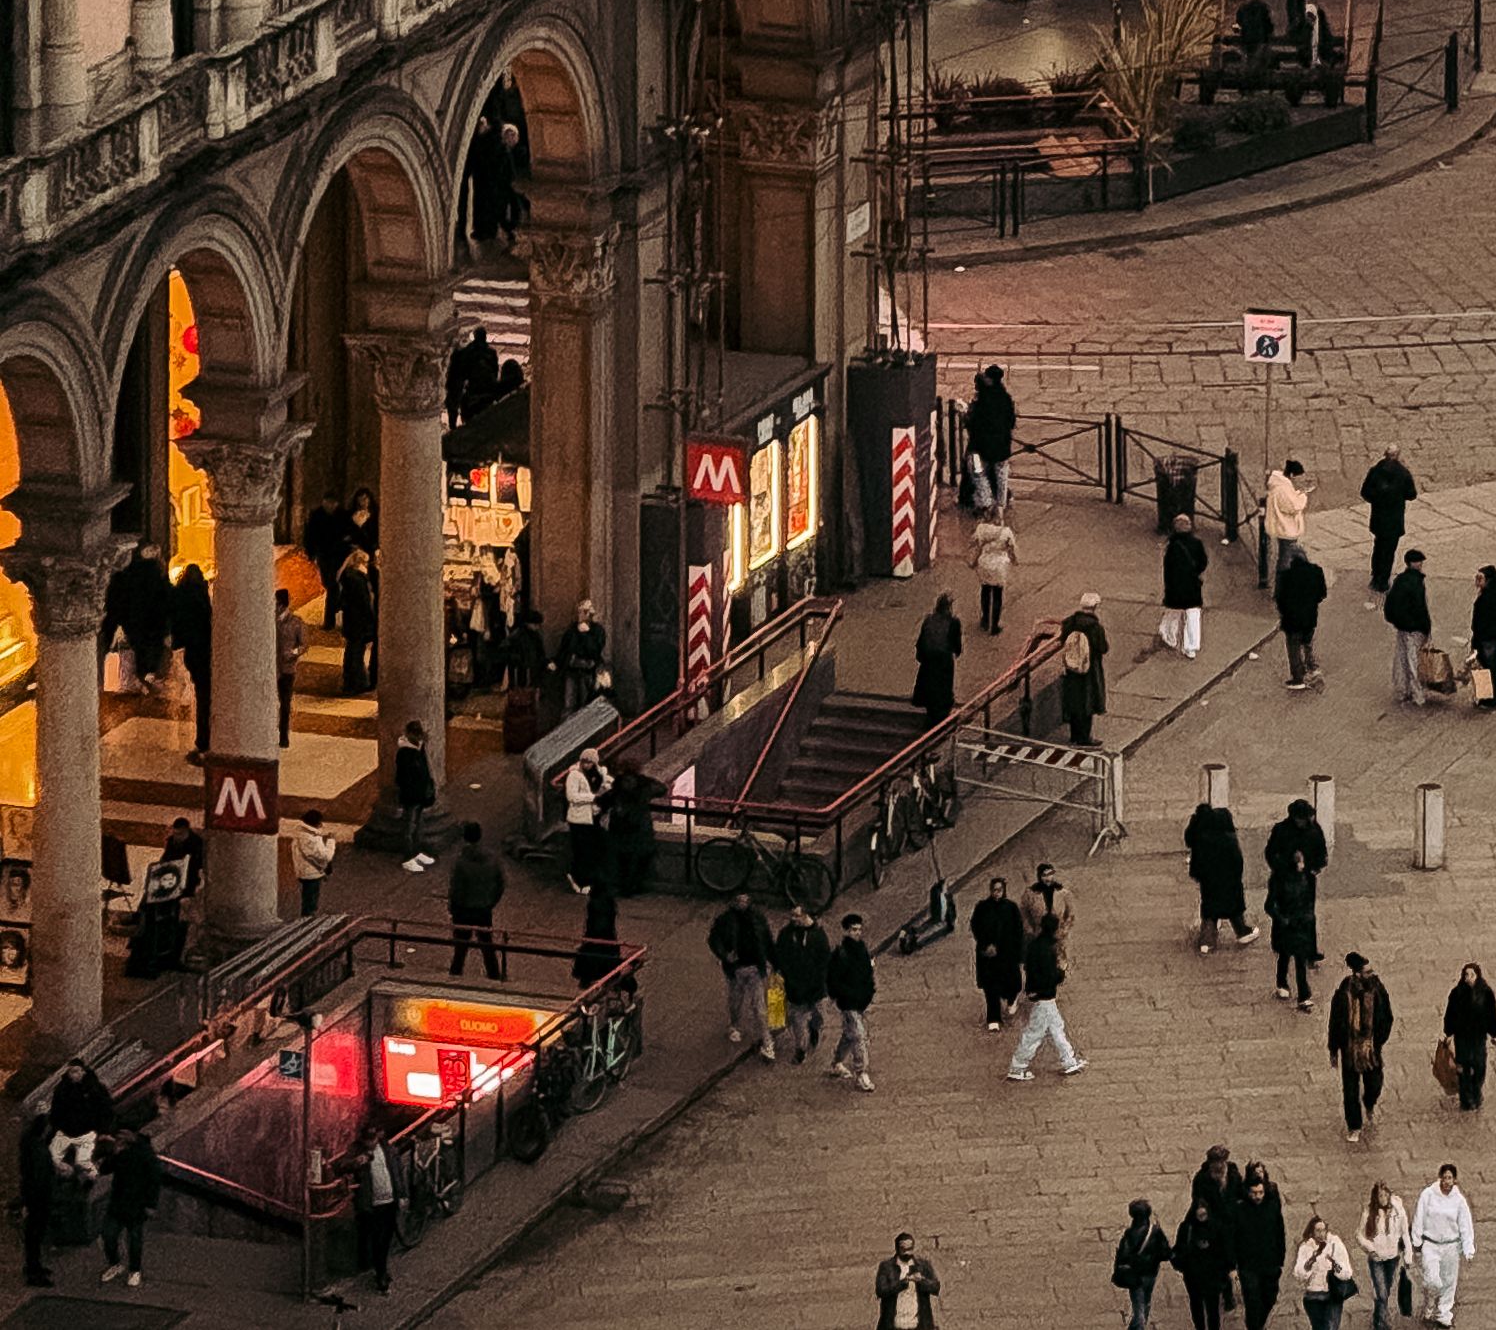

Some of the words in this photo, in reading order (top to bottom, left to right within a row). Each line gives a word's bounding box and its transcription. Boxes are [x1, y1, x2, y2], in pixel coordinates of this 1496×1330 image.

[693, 453, 741, 494] M
[214, 776, 267, 820] M
[459, 1019, 499, 1033] DUOMO
